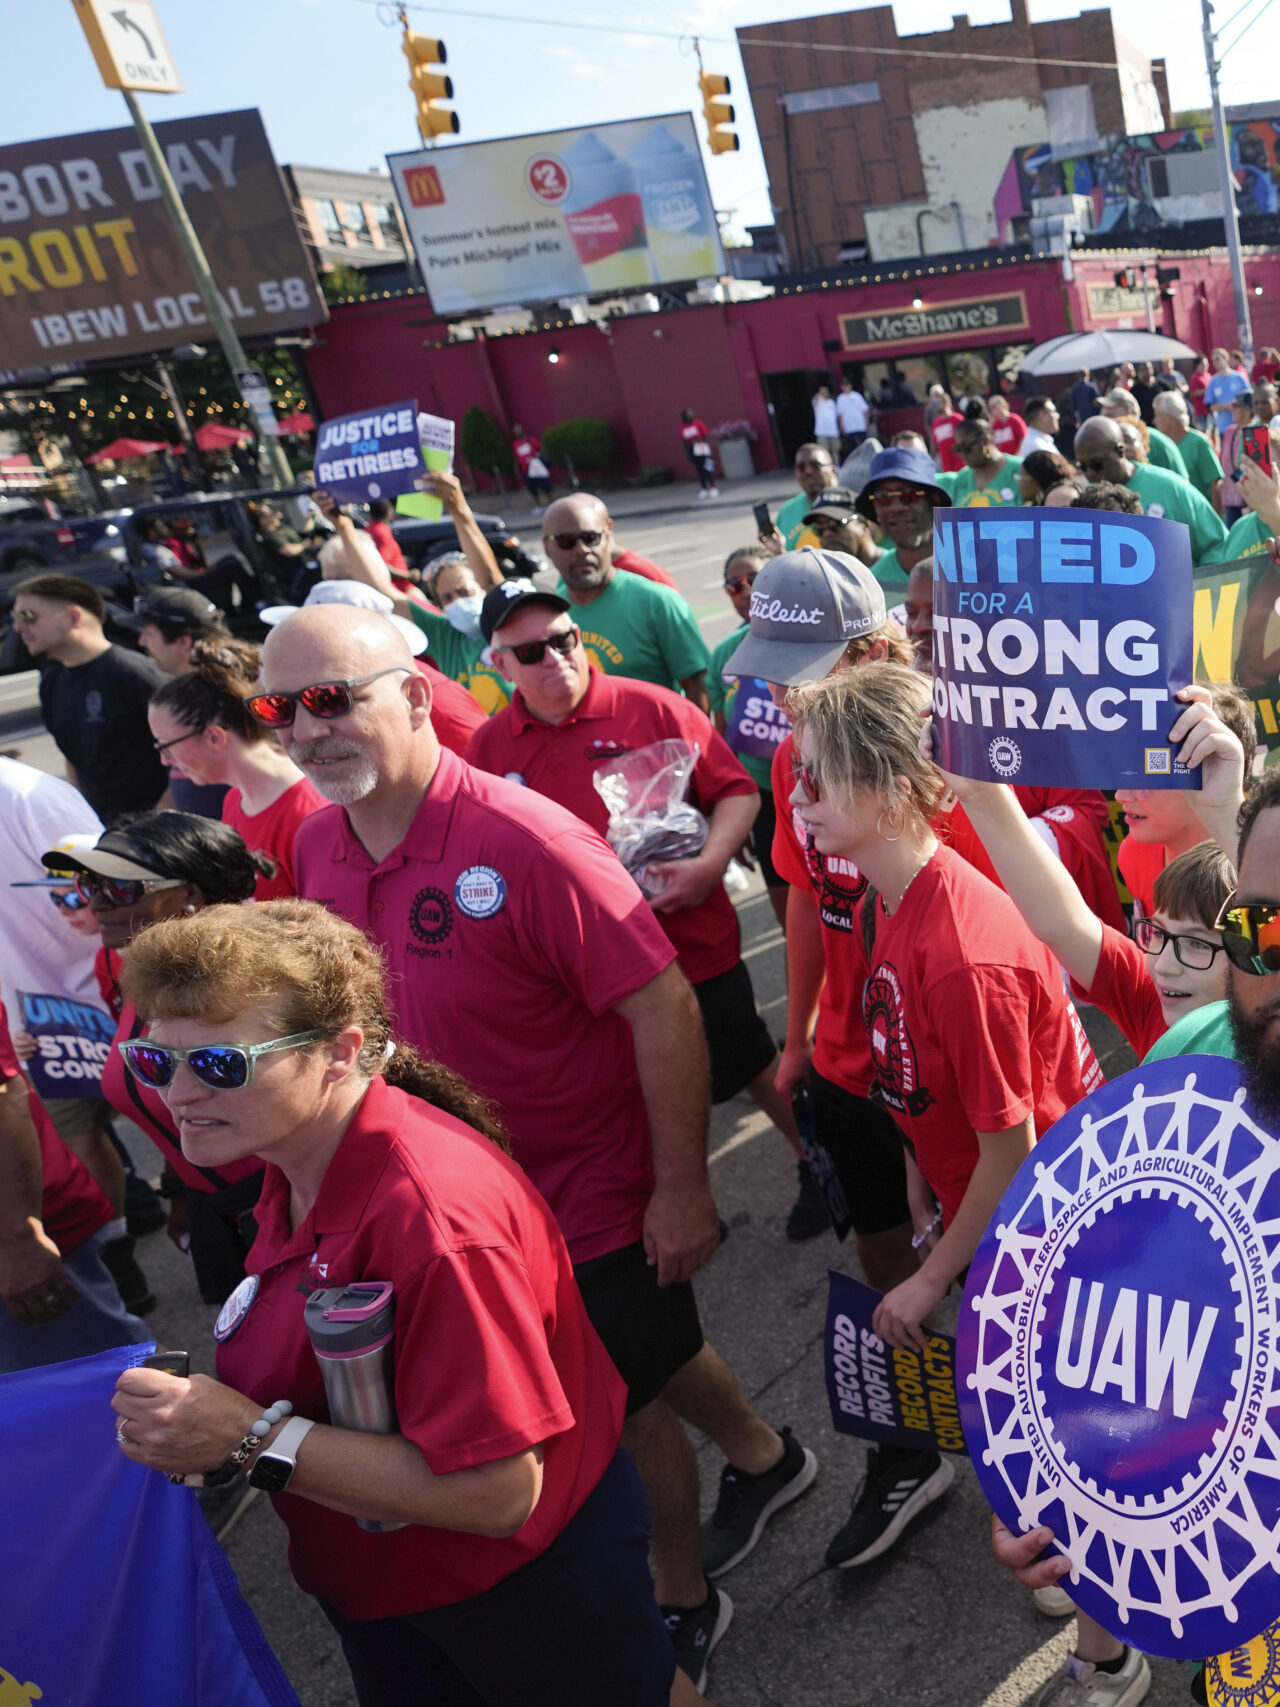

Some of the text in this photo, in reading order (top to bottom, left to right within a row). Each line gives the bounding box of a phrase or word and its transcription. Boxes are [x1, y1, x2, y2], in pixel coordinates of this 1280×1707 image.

[125, 62, 169, 82] ONLY
[119, 135, 238, 201] DAY
[422, 228, 483, 247] Summer's
[485, 220, 532, 237] hottest
[428, 254, 461, 269] Pure
[535, 239, 562, 254] Mix
[32, 304, 129, 348] IBEW
[258, 276, 310, 314] 58
[866, 304, 999, 341] McShane's
[320, 409, 413, 449] JUSTICE
[351, 439, 379, 456] FOR
[319, 447, 419, 483] RETIREES
[749, 591, 825, 625] Titleist
[958, 592, 1034, 615] FOR A
[843, 618, 870, 632] PRO
[582, 631, 623, 664] UNITED
[932, 614, 1160, 676] TRONG
[932, 677, 1168, 731] ONTRACT
[997, 752, 1012, 762] UAW
[470, 866, 499, 879] REGION
[828, 856, 858, 879] UAW
[462, 887, 494, 899] STRIKE
[420, 908, 441, 923] UAW
[822, 908, 853, 929] LOCAL
[406, 943, 453, 960] Region 1
[902, 1057, 913, 1092] EVER
[1015, 1156, 1271, 1535] UNITED AUTOMOBILE, AEROSPACE AND AGRICULTURAL IMPLEMENT WORKERS OF AMERICA
[1055, 1276, 1219, 1419] UAW
[833, 1313, 865, 1418] RECORD
[860, 1328, 896, 1427] PROFITS
[893, 1347, 930, 1431] RECORD
[922, 1336, 965, 1450] CONTRACTS
